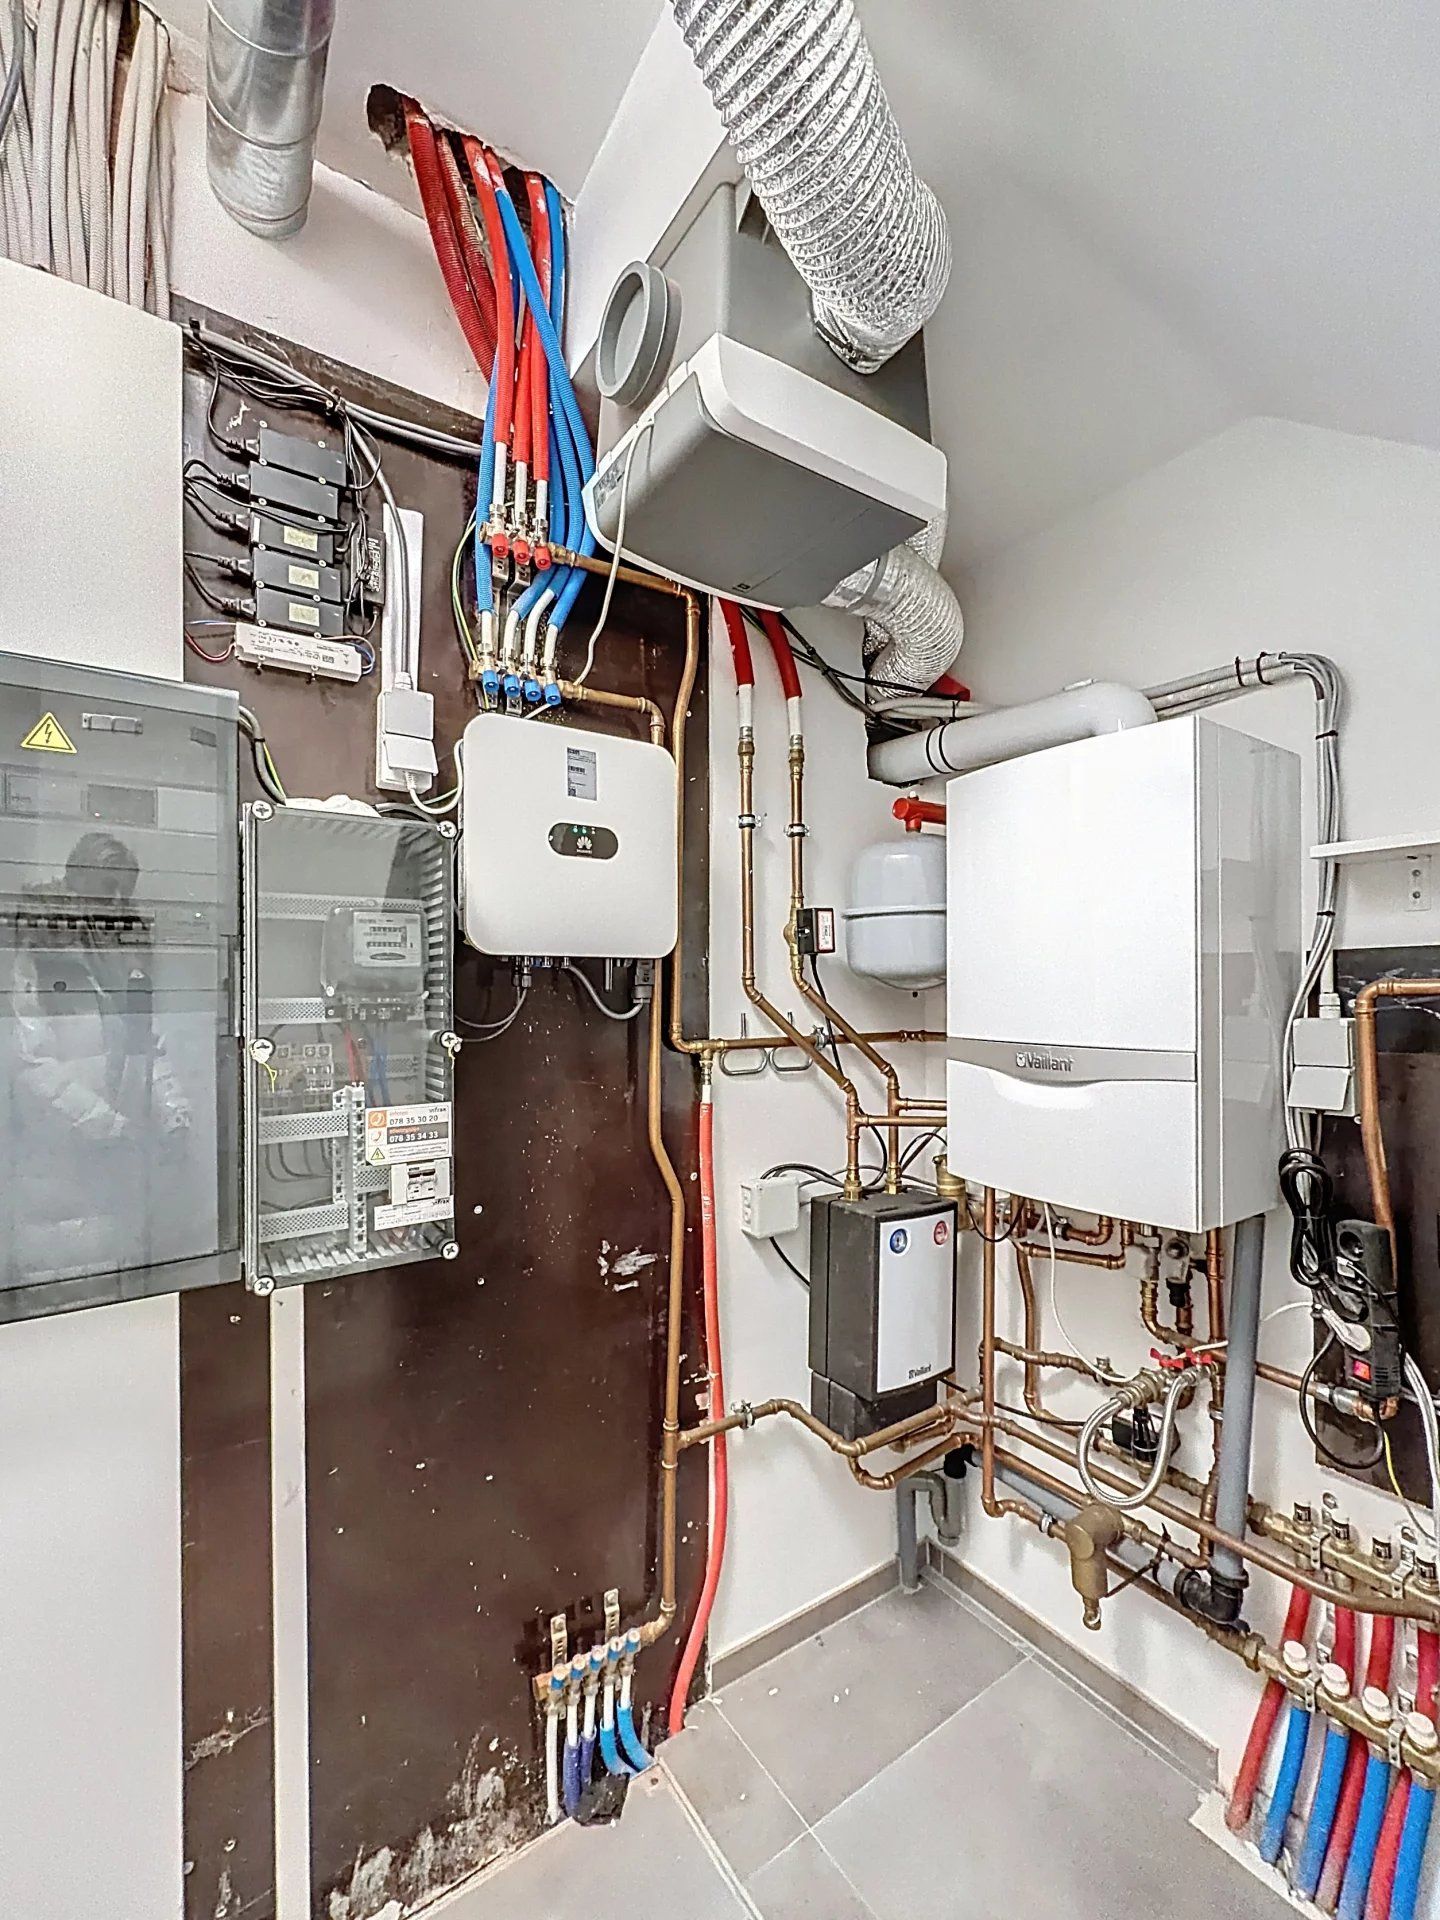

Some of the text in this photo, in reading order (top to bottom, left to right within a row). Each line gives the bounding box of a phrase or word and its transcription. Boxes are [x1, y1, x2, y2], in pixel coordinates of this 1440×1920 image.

[1025, 1051, 1074, 1072] Vaillant
[389, 1118, 404, 1126] 078
[417, 1115, 427, 1123] 30
[428, 1114, 439, 1122] 20
[389, 1135, 404, 1143] 078
[405, 1133, 416, 1142] 35
[417, 1132, 427, 1140] 34
[428, 1130, 439, 1139] 33
